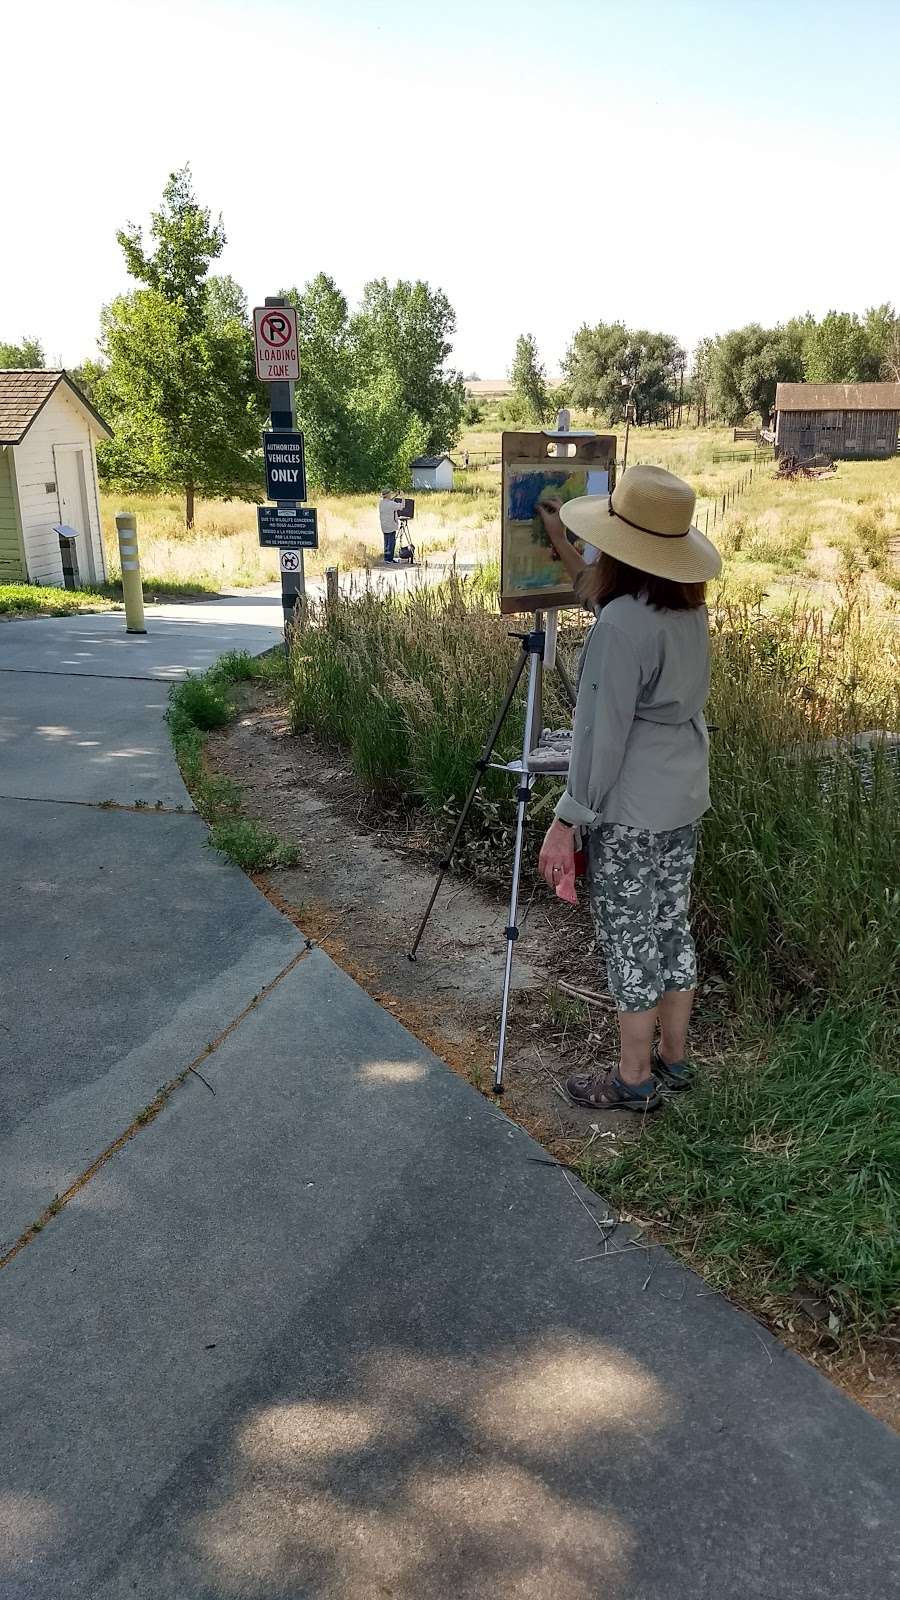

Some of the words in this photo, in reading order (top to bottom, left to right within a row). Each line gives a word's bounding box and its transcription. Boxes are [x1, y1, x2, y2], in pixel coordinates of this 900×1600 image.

[259, 349, 296, 361] LOADING
[268, 364, 290, 377] ZONE
[267, 443, 300, 451] AUTHORIZED
[268, 453, 300, 463] VEHICLES
[271, 468, 299, 482] ONLY
